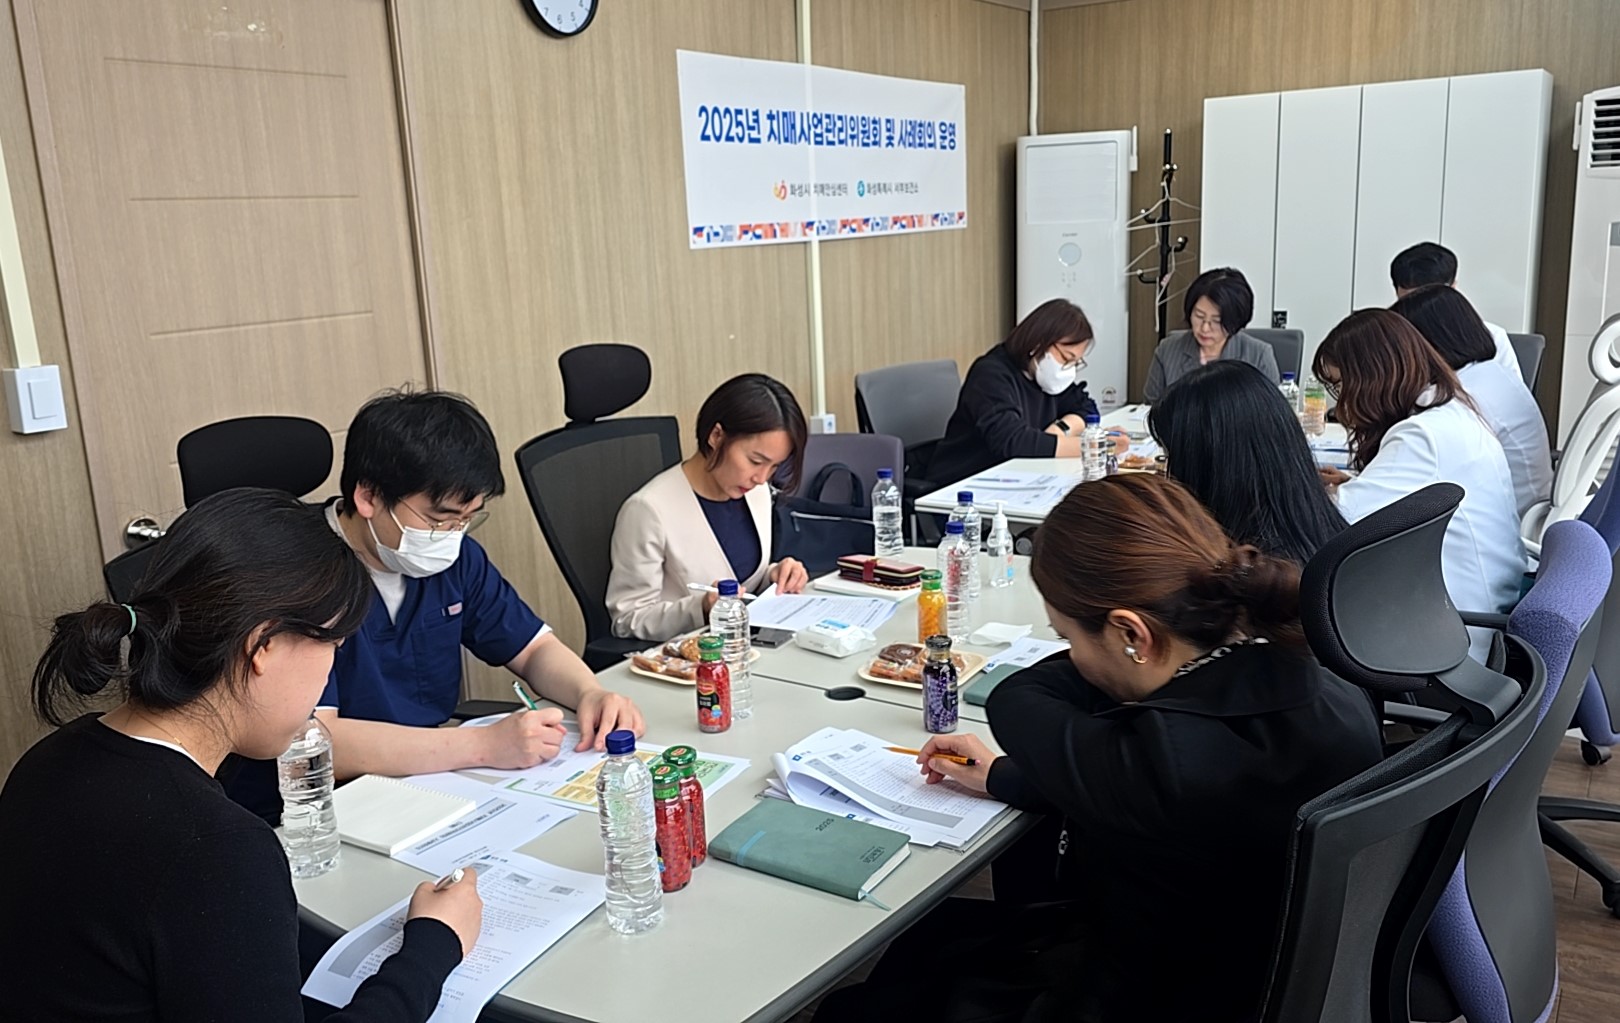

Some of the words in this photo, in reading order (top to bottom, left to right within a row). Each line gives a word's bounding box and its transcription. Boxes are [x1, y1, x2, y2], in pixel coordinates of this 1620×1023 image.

[543, 7, 549, 16] 7
[570, 11, 576, 21] 5
[557, 14, 563, 25] 6
[698, 105, 762, 144] 2025년
[766, 109, 882, 148] 치매사업관리위원회
[885, 118, 896, 148] 및
[897, 119, 937, 149] 사례회의
[938, 121, 957, 150] 운영
[789, 183, 811, 198] 화성시
